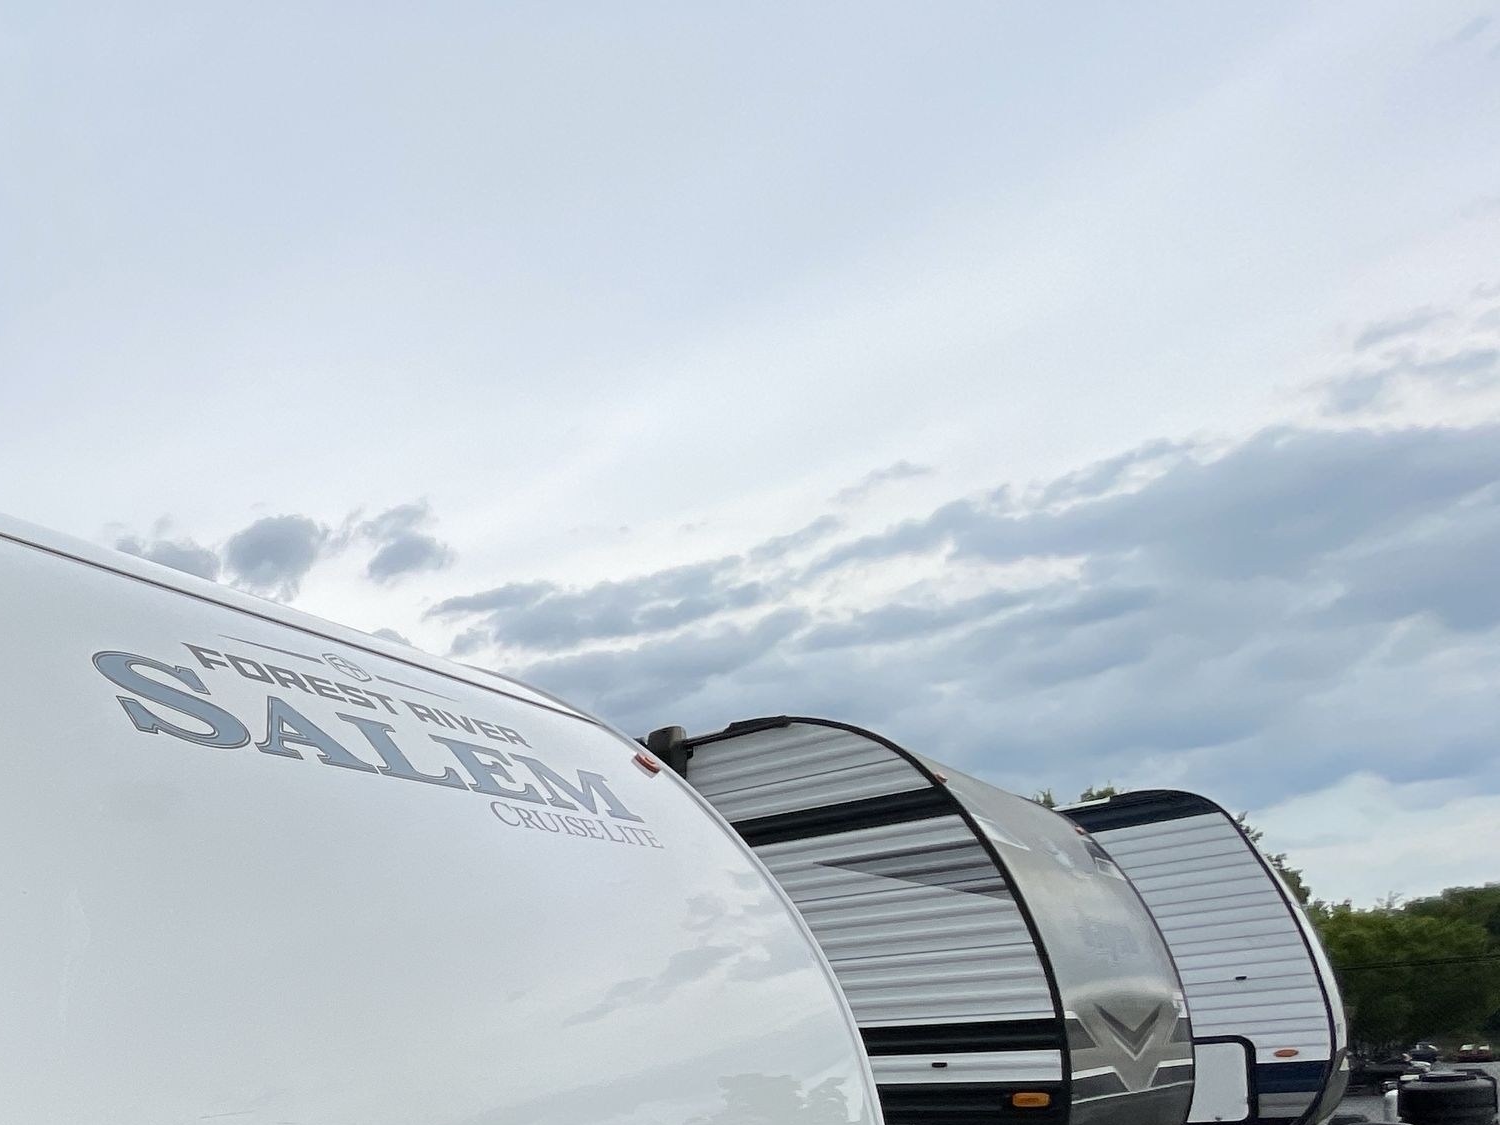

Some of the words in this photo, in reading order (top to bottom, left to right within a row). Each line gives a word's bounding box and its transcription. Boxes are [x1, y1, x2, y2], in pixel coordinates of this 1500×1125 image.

[92, 650, 645, 824] SALEM
[181, 641, 399, 716] FOREST
[401, 699, 532, 749] RIVER
[490, 800, 665, 850] CRUISELITE
